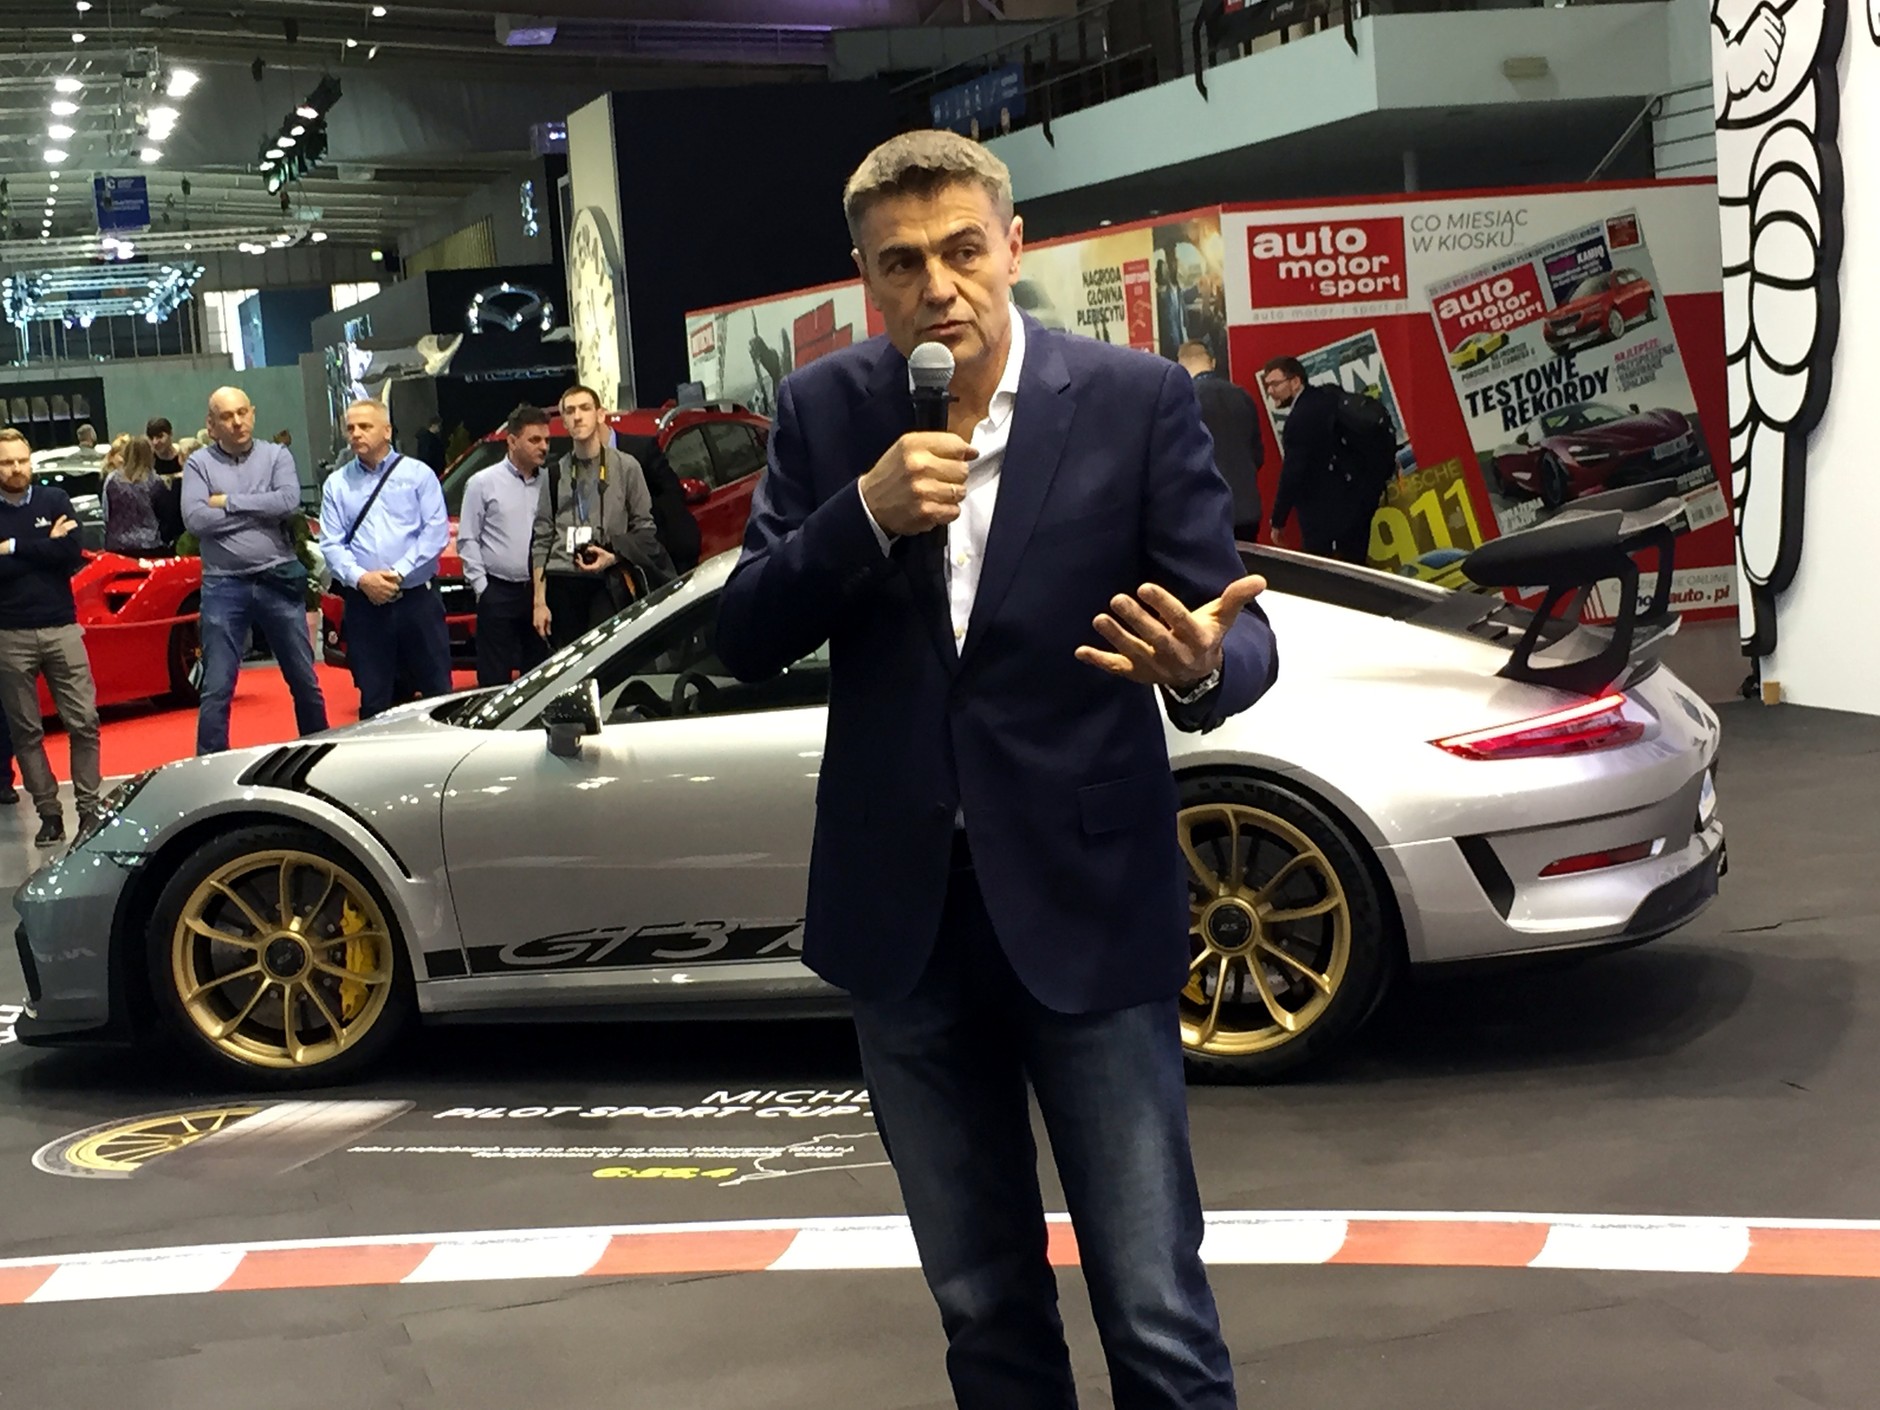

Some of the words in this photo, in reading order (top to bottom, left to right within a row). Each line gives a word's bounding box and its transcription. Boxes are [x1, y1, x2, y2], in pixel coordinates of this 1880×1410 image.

[1410, 215, 1441, 234] CO
[1252, 225, 1368, 260] auto
[1412, 236, 1432, 253] W
[1082, 266, 1122, 288] NAGRODA
[1278, 254, 1390, 280] motor
[1319, 274, 1401, 298] sport
[1438, 277, 1515, 320] auto
[1077, 304, 1125, 326] PLEBISCYTU
[1458, 290, 1532, 329] motor
[1489, 301, 1544, 332] sport
[1464, 354, 1580, 418] TESTOWE
[1502, 365, 1610, 432] REKORDY
[1367, 478, 1483, 566] 911
[500, 920, 740, 965] GT3
[432, 1106, 583, 1119] PILOT
[578, 1105, 754, 1119] SPORT
[755, 1105, 861, 1118] CUP
